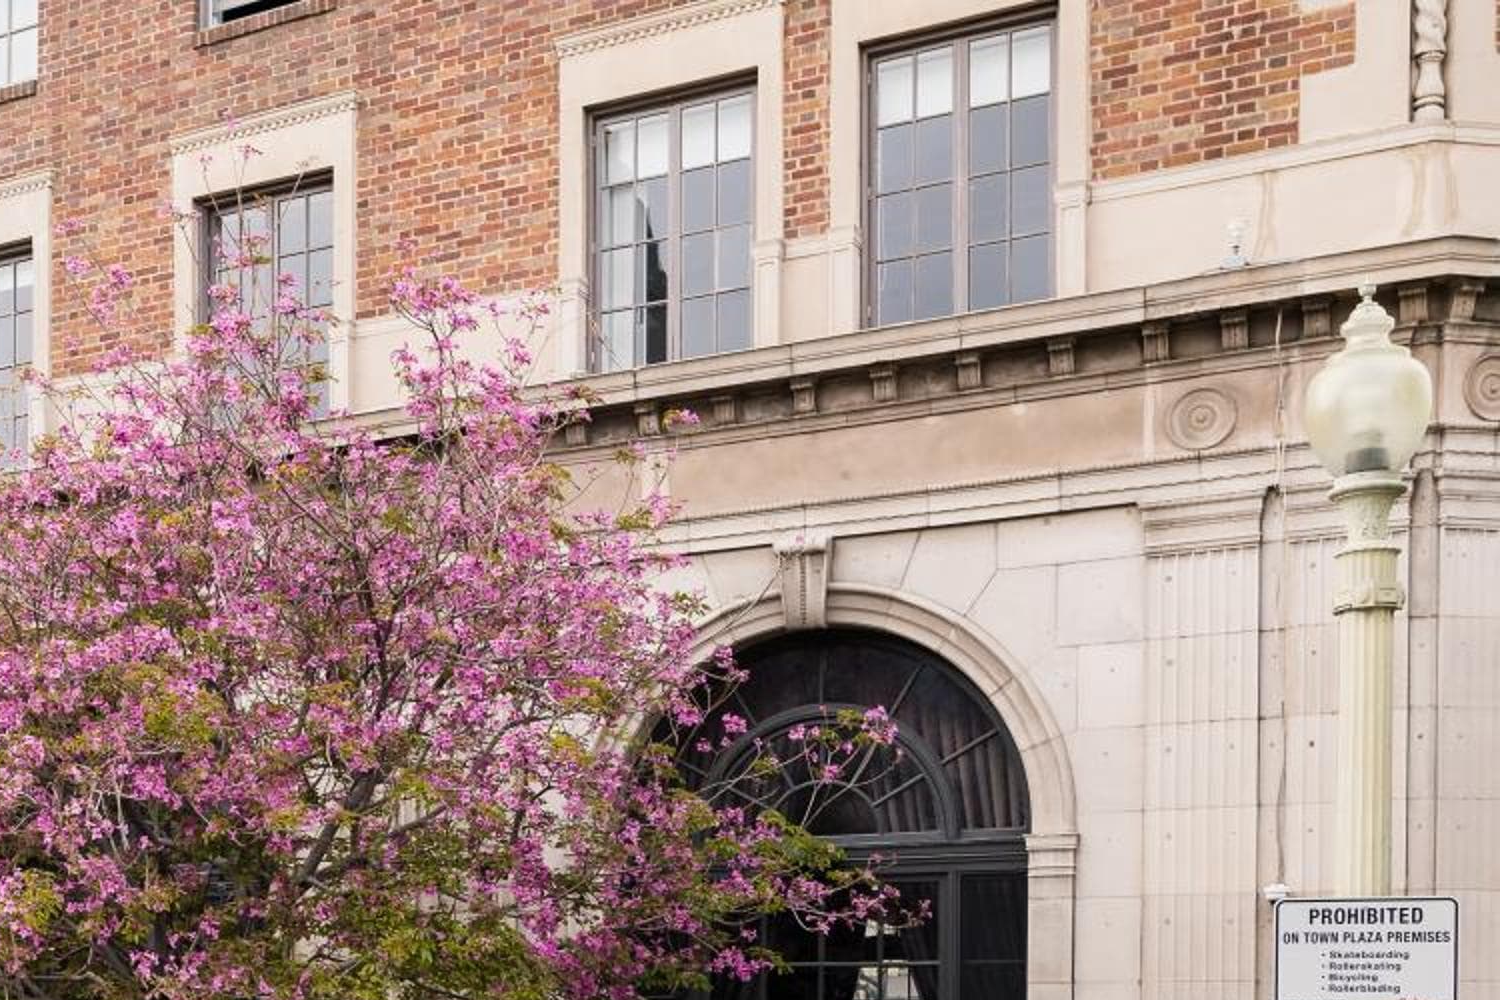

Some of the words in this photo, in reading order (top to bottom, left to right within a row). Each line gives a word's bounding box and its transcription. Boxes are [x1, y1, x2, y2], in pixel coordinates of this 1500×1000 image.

[1308, 906, 1424, 926] PROHIBITED
[1282, 931, 1300, 944] ON
[1303, 931, 1339, 944] TOWN
[1342, 931, 1384, 944] PLAZA
[1386, 930, 1451, 944] PREMISES
[1329, 950, 1411, 961] Skateboarding
[1328, 961, 1402, 972] Rollerskating
[1328, 972, 1379, 983] Bicycling
[1328, 983, 1402, 994] Rollerblading
